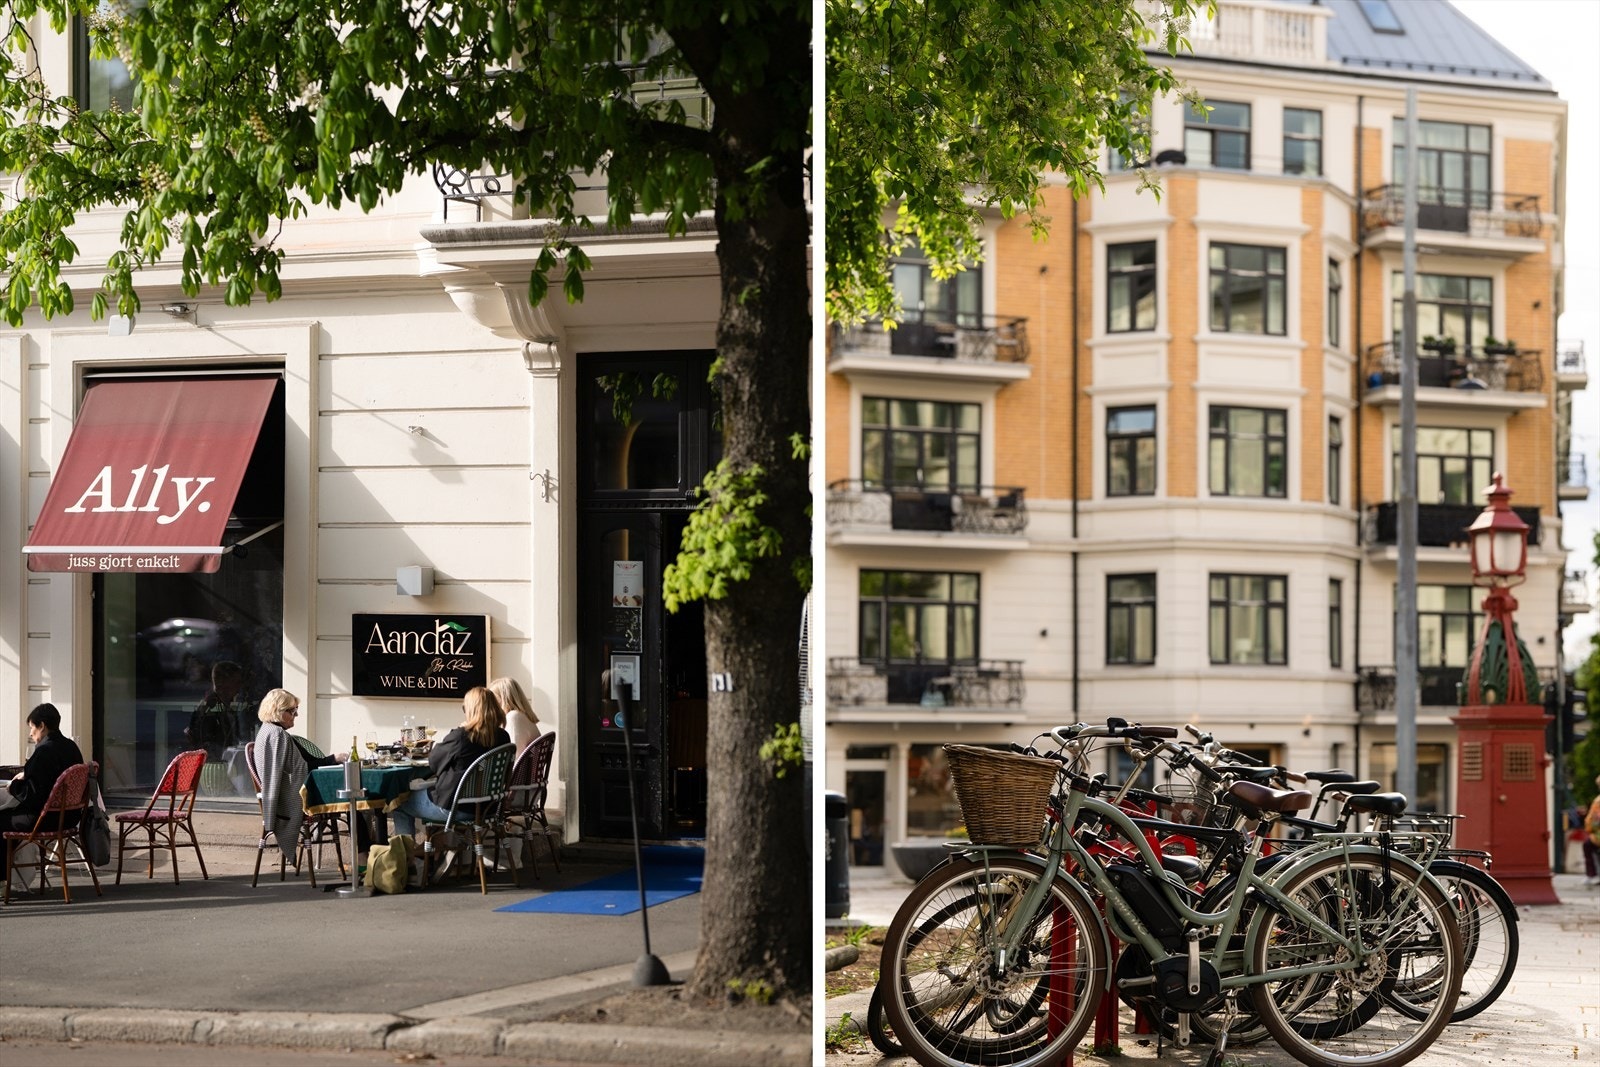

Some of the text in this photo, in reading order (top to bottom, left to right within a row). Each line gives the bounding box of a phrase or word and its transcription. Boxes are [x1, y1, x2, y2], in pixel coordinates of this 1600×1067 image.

[64, 464, 216, 525] Ally.
[67, 554, 180, 570] juss gjort enkelt
[364, 619, 474, 656] Aandaz
[380, 675, 459, 690] WINE & DINE
